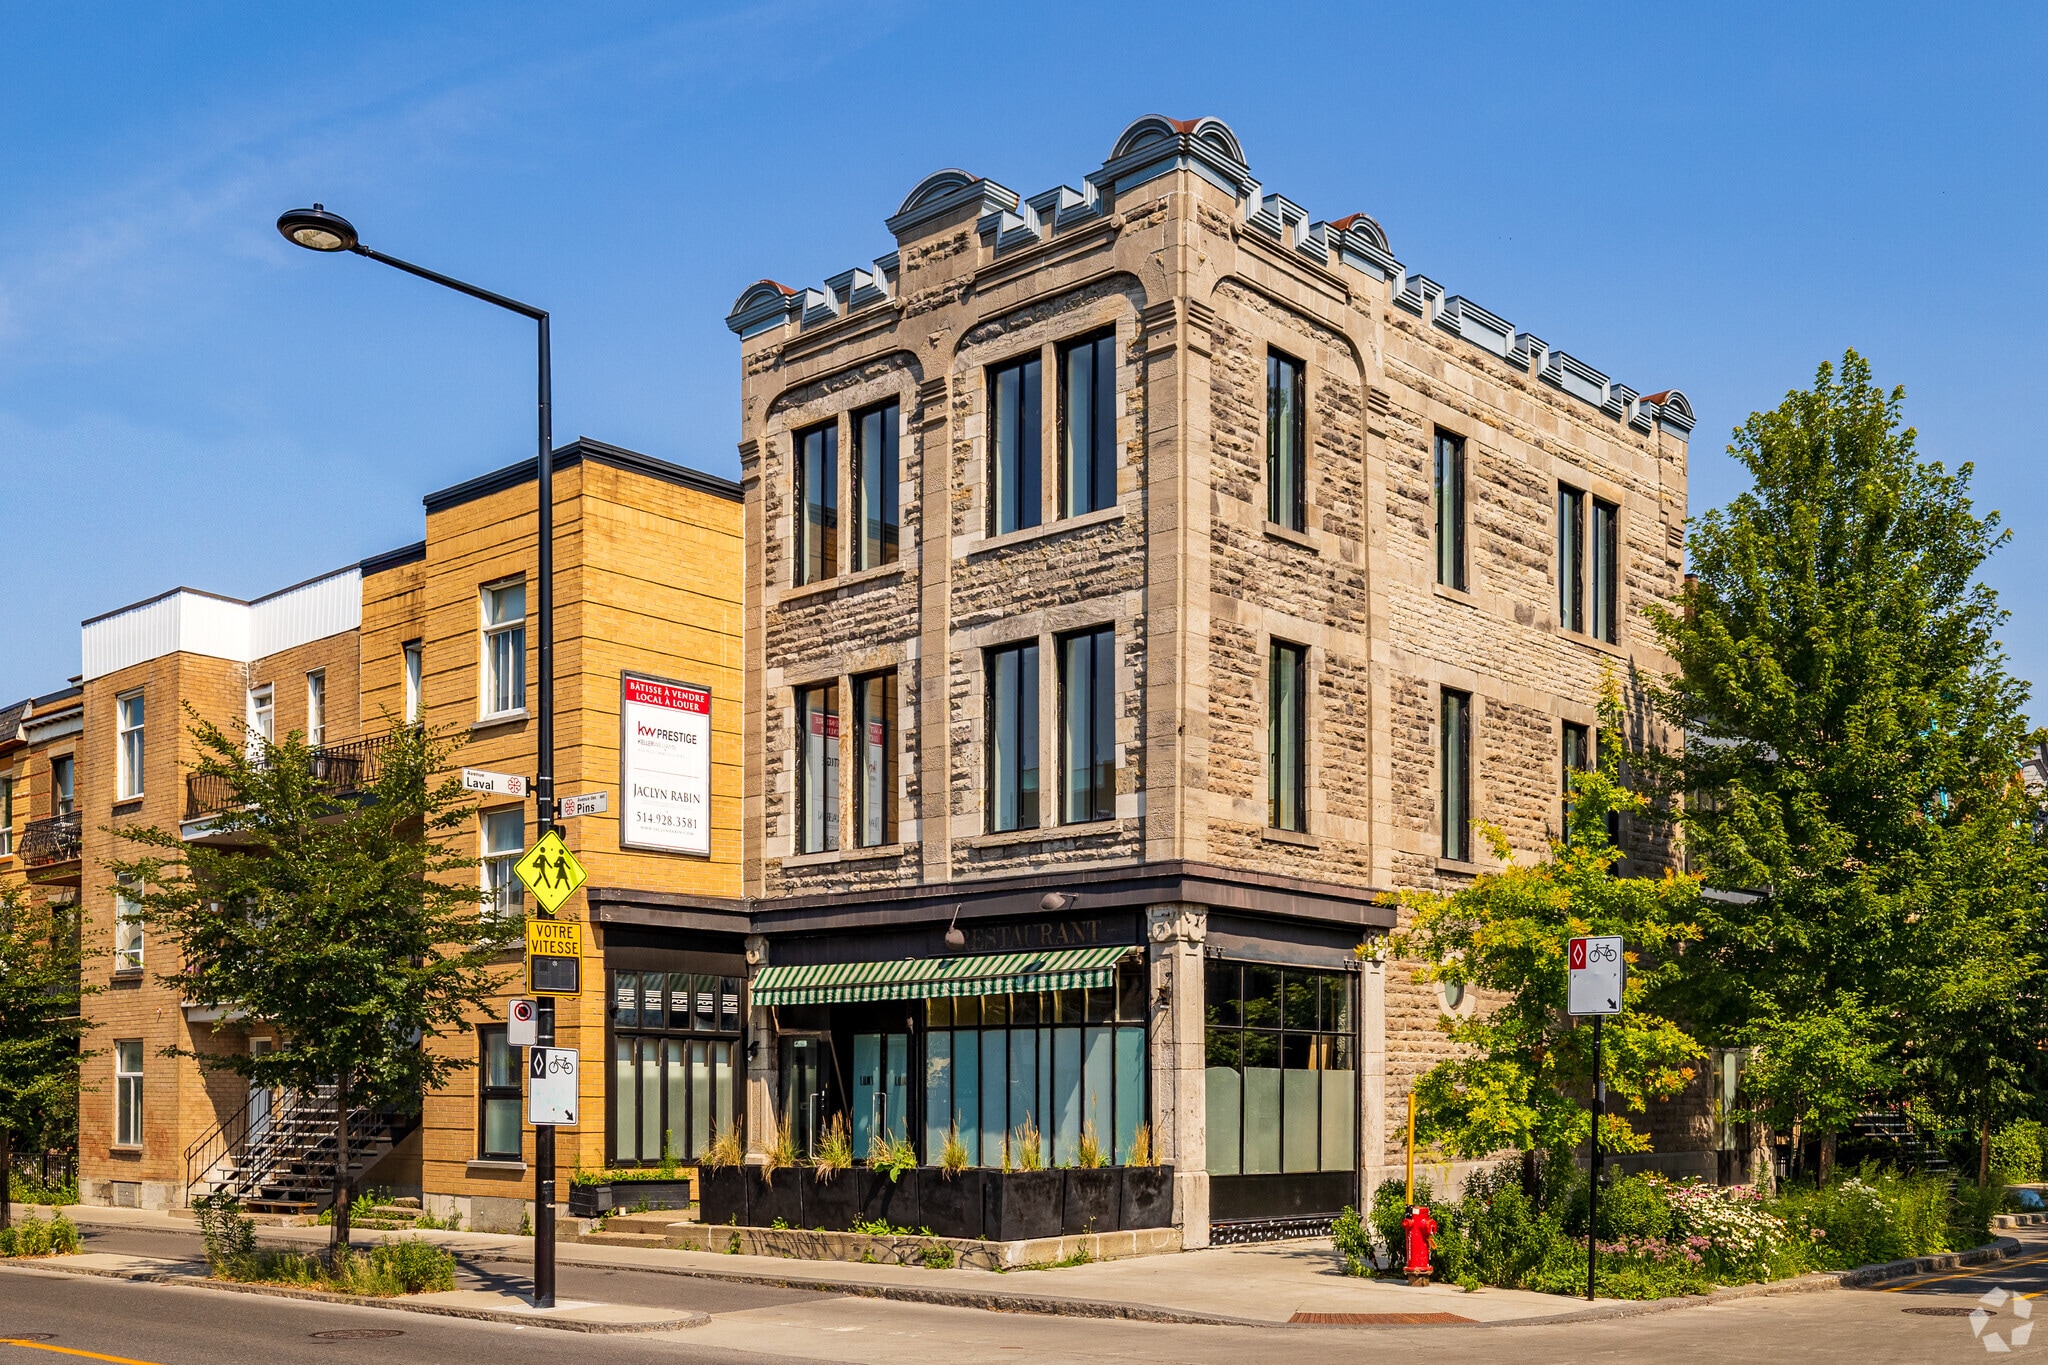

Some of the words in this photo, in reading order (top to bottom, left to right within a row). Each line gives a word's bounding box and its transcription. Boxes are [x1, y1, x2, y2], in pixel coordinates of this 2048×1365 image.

[630, 682, 662, 695] BÂTISSE
[664, 687, 670, 696] À
[672, 690, 705, 703] VENDRE
[636, 692, 663, 704] LOCAL
[665, 697, 670, 706] À
[673, 699, 700, 711] LOUER
[657, 728, 697, 745] PRESTIGE
[467, 770, 485, 778] Avenue
[467, 776, 494, 790] Laval
[633, 783, 667, 800] JACLYN
[671, 790, 701, 804] RABIN
[577, 803, 595, 814] Pins
[636, 811, 697, 829] 514.928.3581
[536, 924, 574, 939] VOTRE
[964, 920, 1102, 951] RESTAURANT
[531, 939, 579, 955] VITESSE
